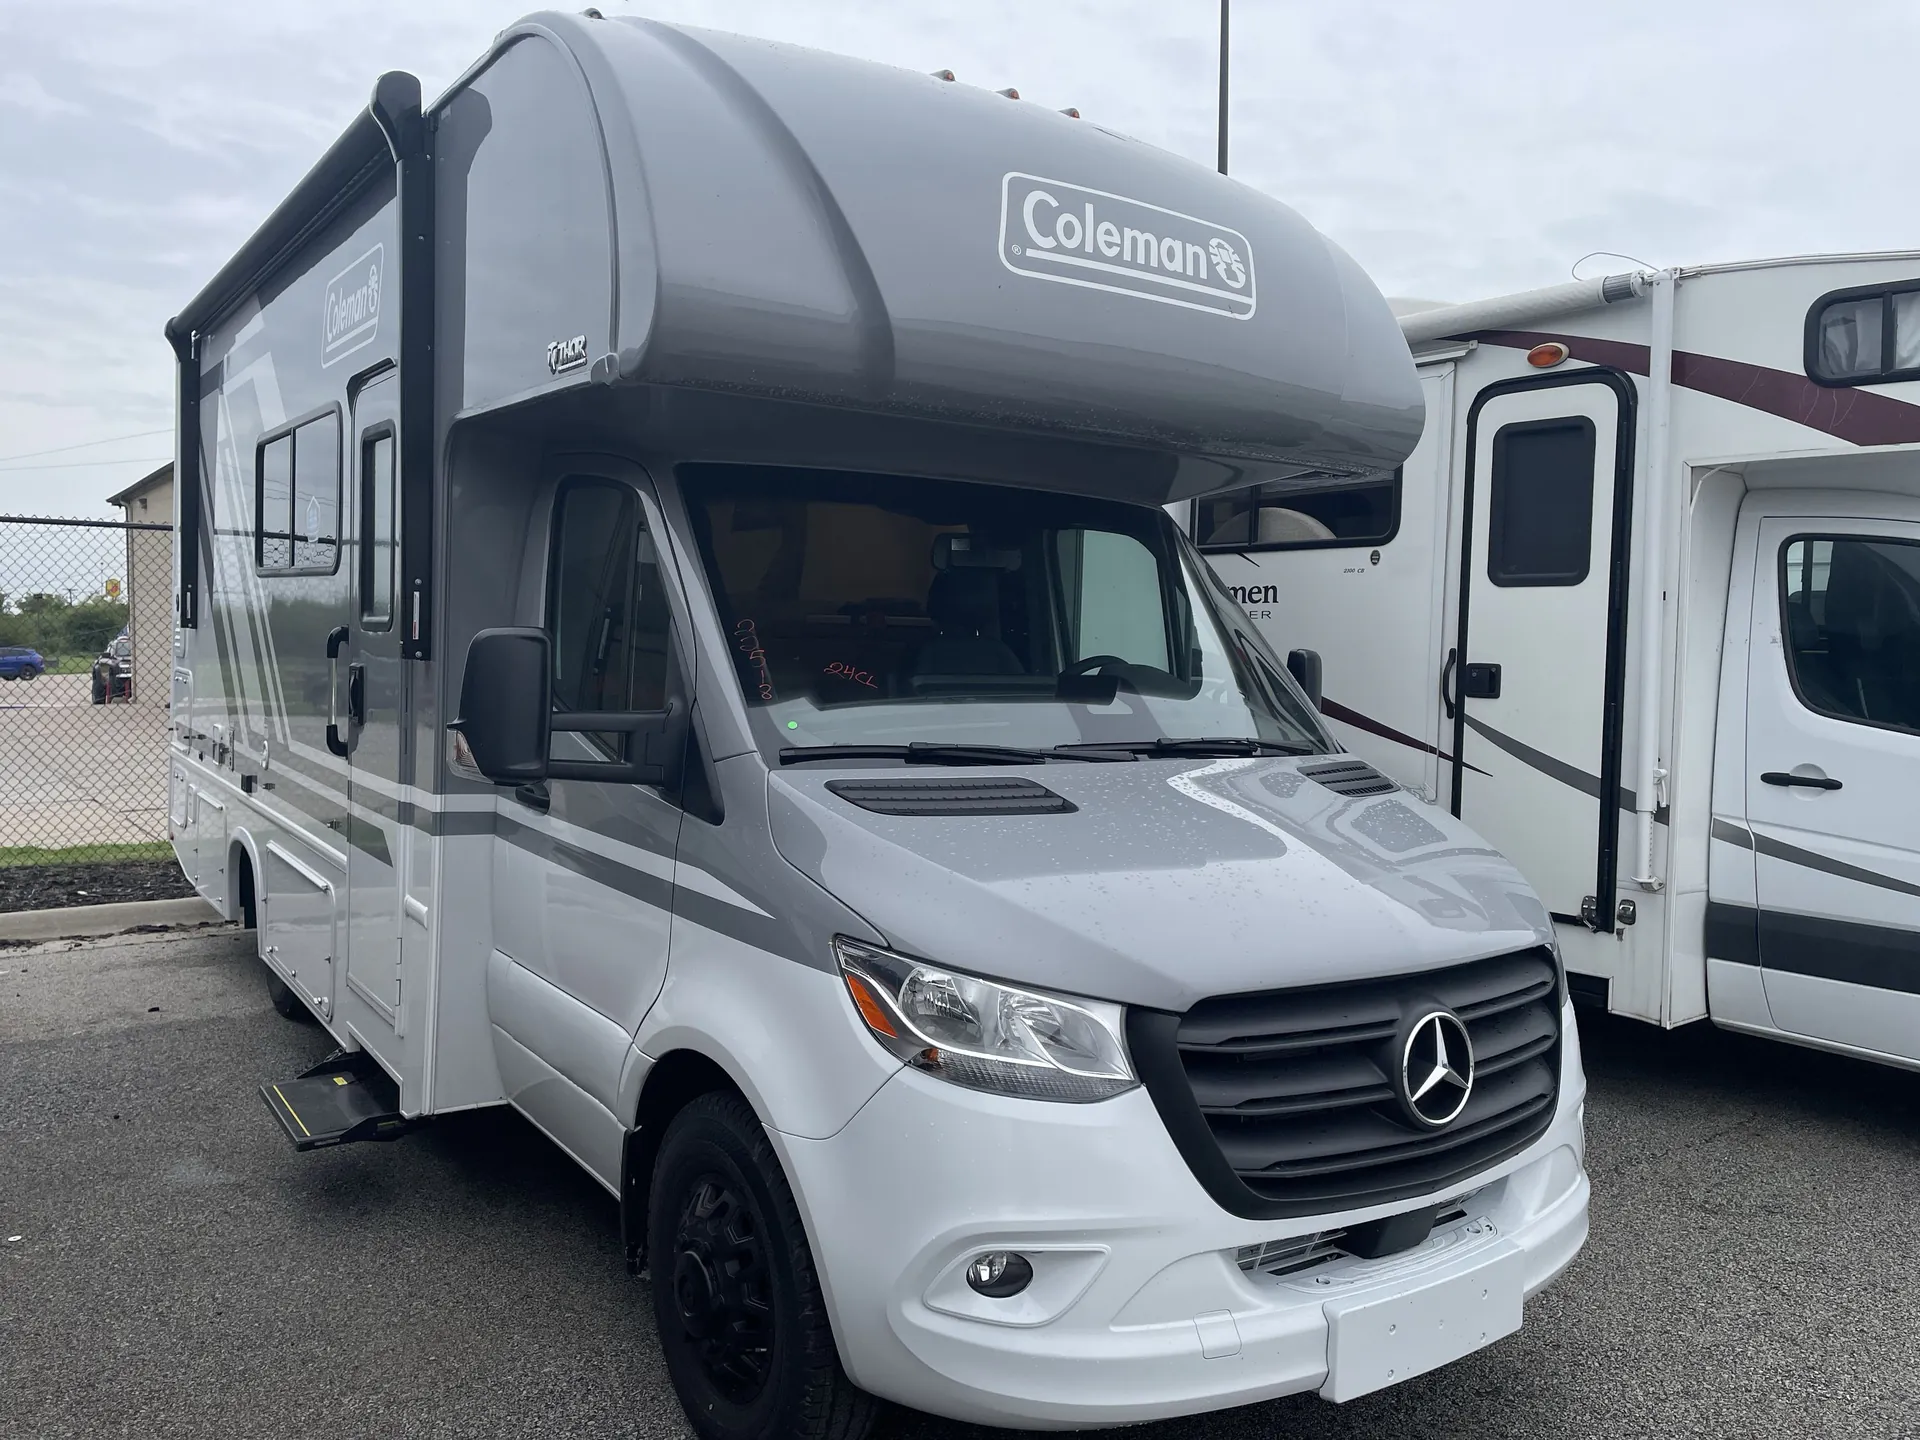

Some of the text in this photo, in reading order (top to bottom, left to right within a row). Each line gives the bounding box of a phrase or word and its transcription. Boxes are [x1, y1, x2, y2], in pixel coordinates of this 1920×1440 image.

[1023, 190, 1208, 280] Coleman
[327, 285, 368, 342] Coleman
[557, 334, 587, 366] THOR
[1227, 584, 1279, 604] men
[1249, 610, 1272, 620] ER
